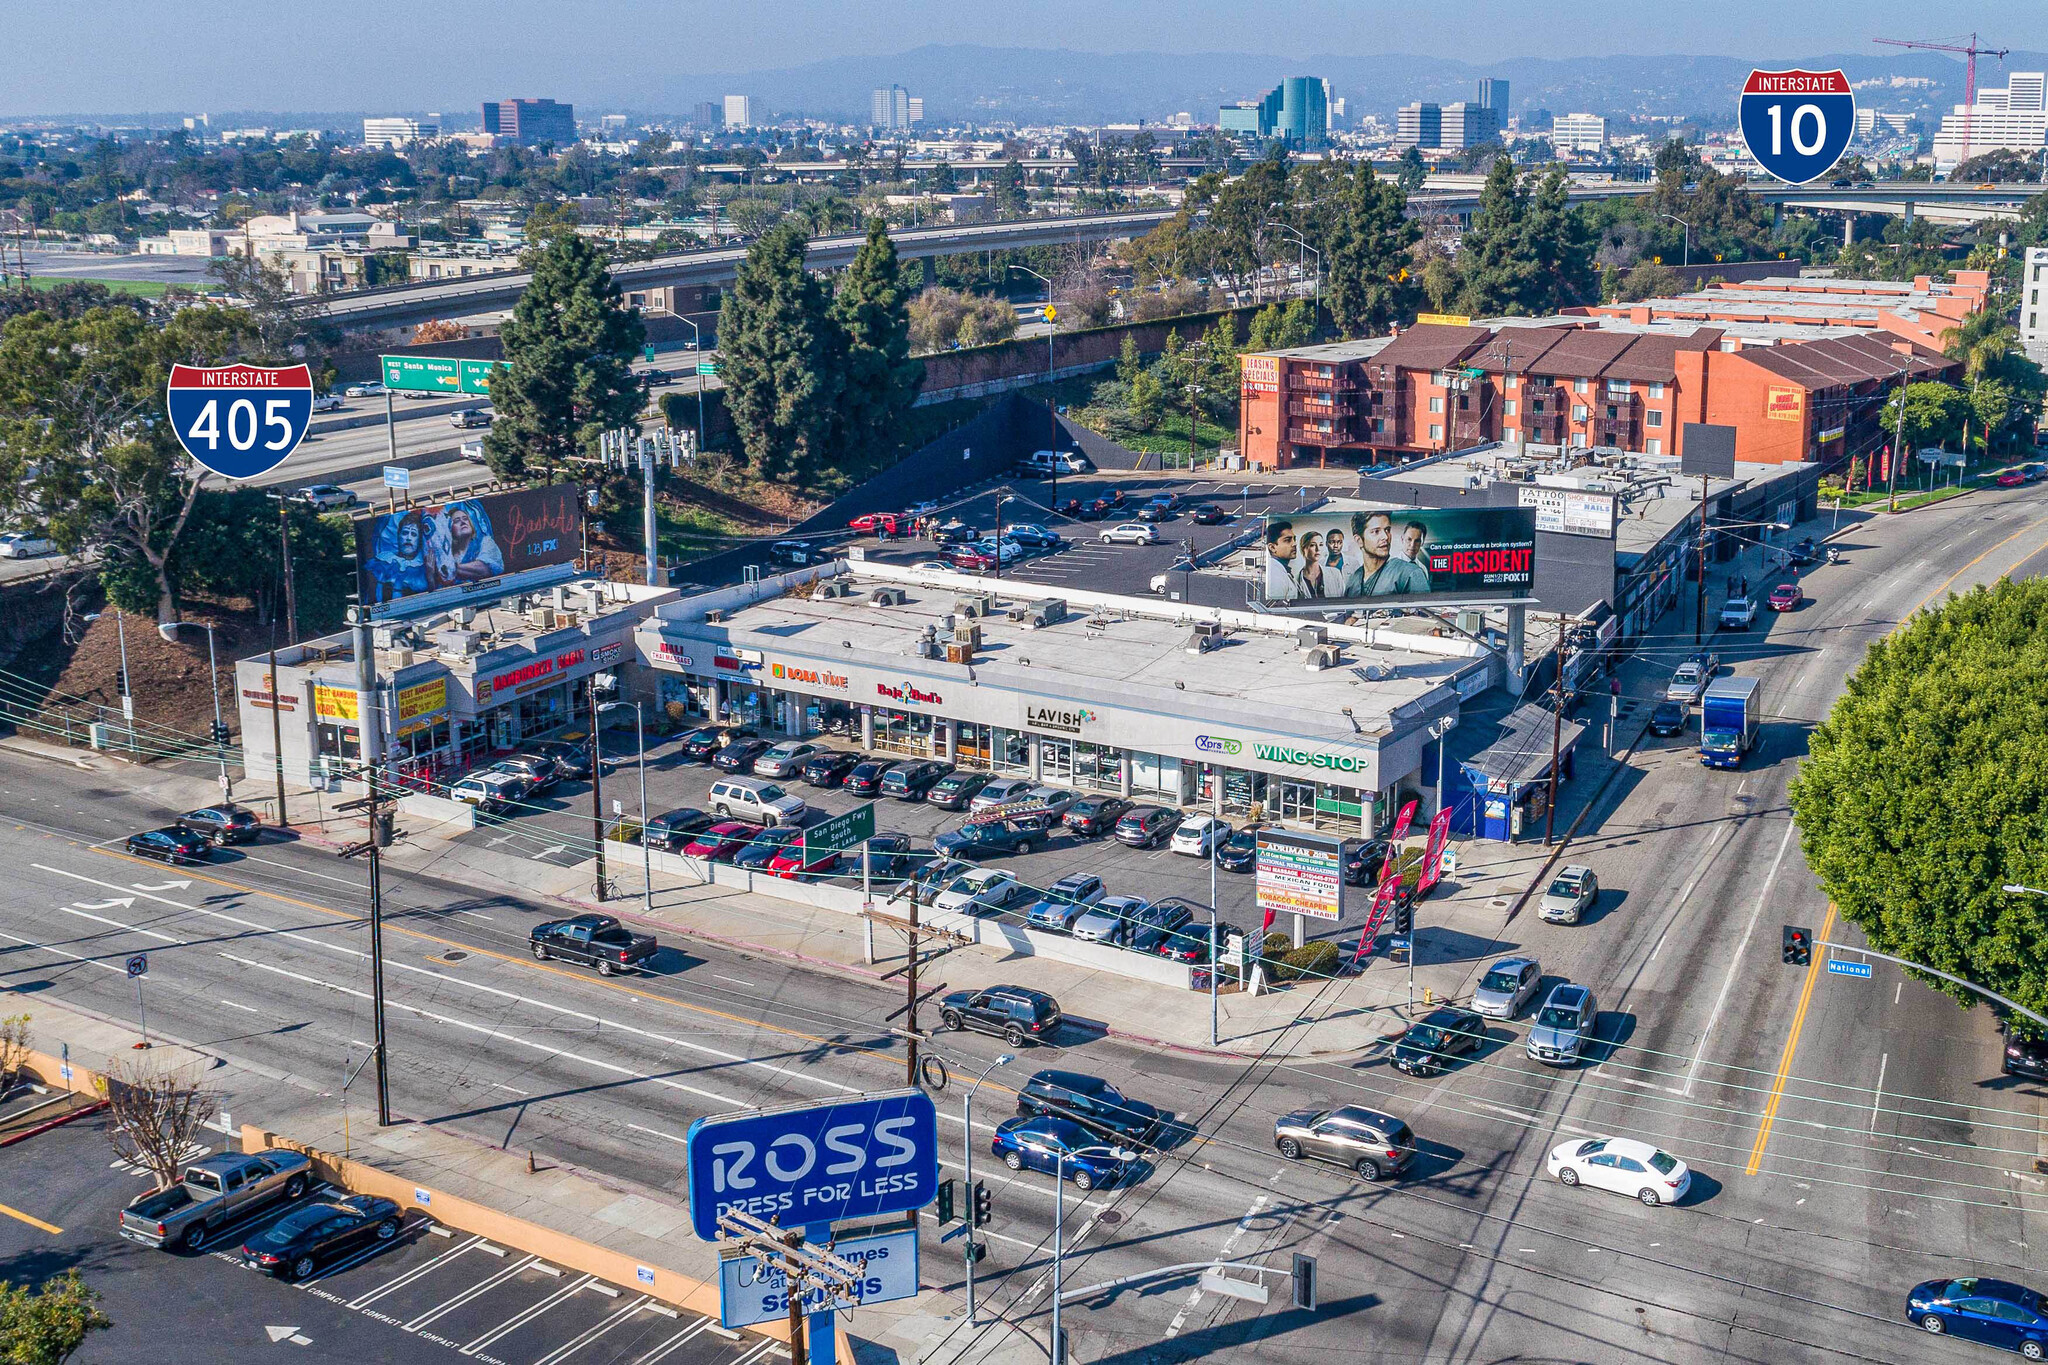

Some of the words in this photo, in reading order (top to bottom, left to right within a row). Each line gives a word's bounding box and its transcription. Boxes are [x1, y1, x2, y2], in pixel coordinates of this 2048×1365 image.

[403, 361, 424, 370] Santa
[427, 363, 453, 372] Monica
[1246, 358, 1275, 371] LEASING
[1243, 369, 1278, 383] SPECIALS!
[1521, 488, 1564, 499] TATTOO
[1567, 493, 1585, 501] SHOE
[1587, 495, 1612, 503] REPAIR
[1523, 497, 1538, 505] FOR
[1541, 499, 1561, 507] LESS
[1583, 503, 1610, 512] NAILS
[1433, 558, 1448, 569] THE
[1452, 549, 1533, 574] RESIDENT
[1503, 573, 1520, 582] FOX
[1521, 573, 1529, 582] 11
[600, 647, 621, 659] SMOKE
[665, 653, 691, 665] MASSAGE
[493, 659, 553, 692] HAMBURGER
[557, 648, 585, 670] HABIT
[787, 667, 820, 684] BOBA
[316, 687, 331, 697] BEST
[331, 688, 358, 699] HAMBURG
[400, 690, 413, 700] BEST
[415, 680, 445, 694] HAMBURGER
[877, 683, 903, 699] Baja
[910, 688, 943, 705] Bud's
[316, 703, 336, 716] KABC
[400, 707, 419, 720] KABC
[1027, 706, 1081, 727] LAVISH
[1200, 736, 1222, 750] Xprs
[1223, 740, 1237, 752] Rx
[814, 827, 828, 839] San
[830, 818, 850, 832] Diego
[852, 810, 867, 822] Fwy
[830, 827, 852, 842] South
[824, 842, 839, 854] LEFT
[841, 834, 857, 847] LANE
[1258, 857, 1286, 867] NATIONAL
[1258, 864, 1272, 872] THAI
[1272, 867, 1298, 876] MASSAGE
[1274, 874, 1311, 885] MEXICAN
[1313, 881, 1335, 890] FOOD
[1258, 892, 1292, 904] TOBACCO
[1294, 899, 1328, 911] CHEAPER
[1265, 901, 1312, 914] HAMBURGER
[1830, 963, 1870, 975] National
[712, 1116, 917, 1193] ROSS
[716, 1191, 794, 1219] DRESS
[803, 1183, 851, 1206] FOR
[860, 1172, 918, 1197] LESS
[307, 1287, 347, 1306] COMPACT
[361, 1308, 403, 1327] COMPACT
[417, 1330, 460, 1349] COMPACT
[474, 1353, 511, 1365] COMPA
